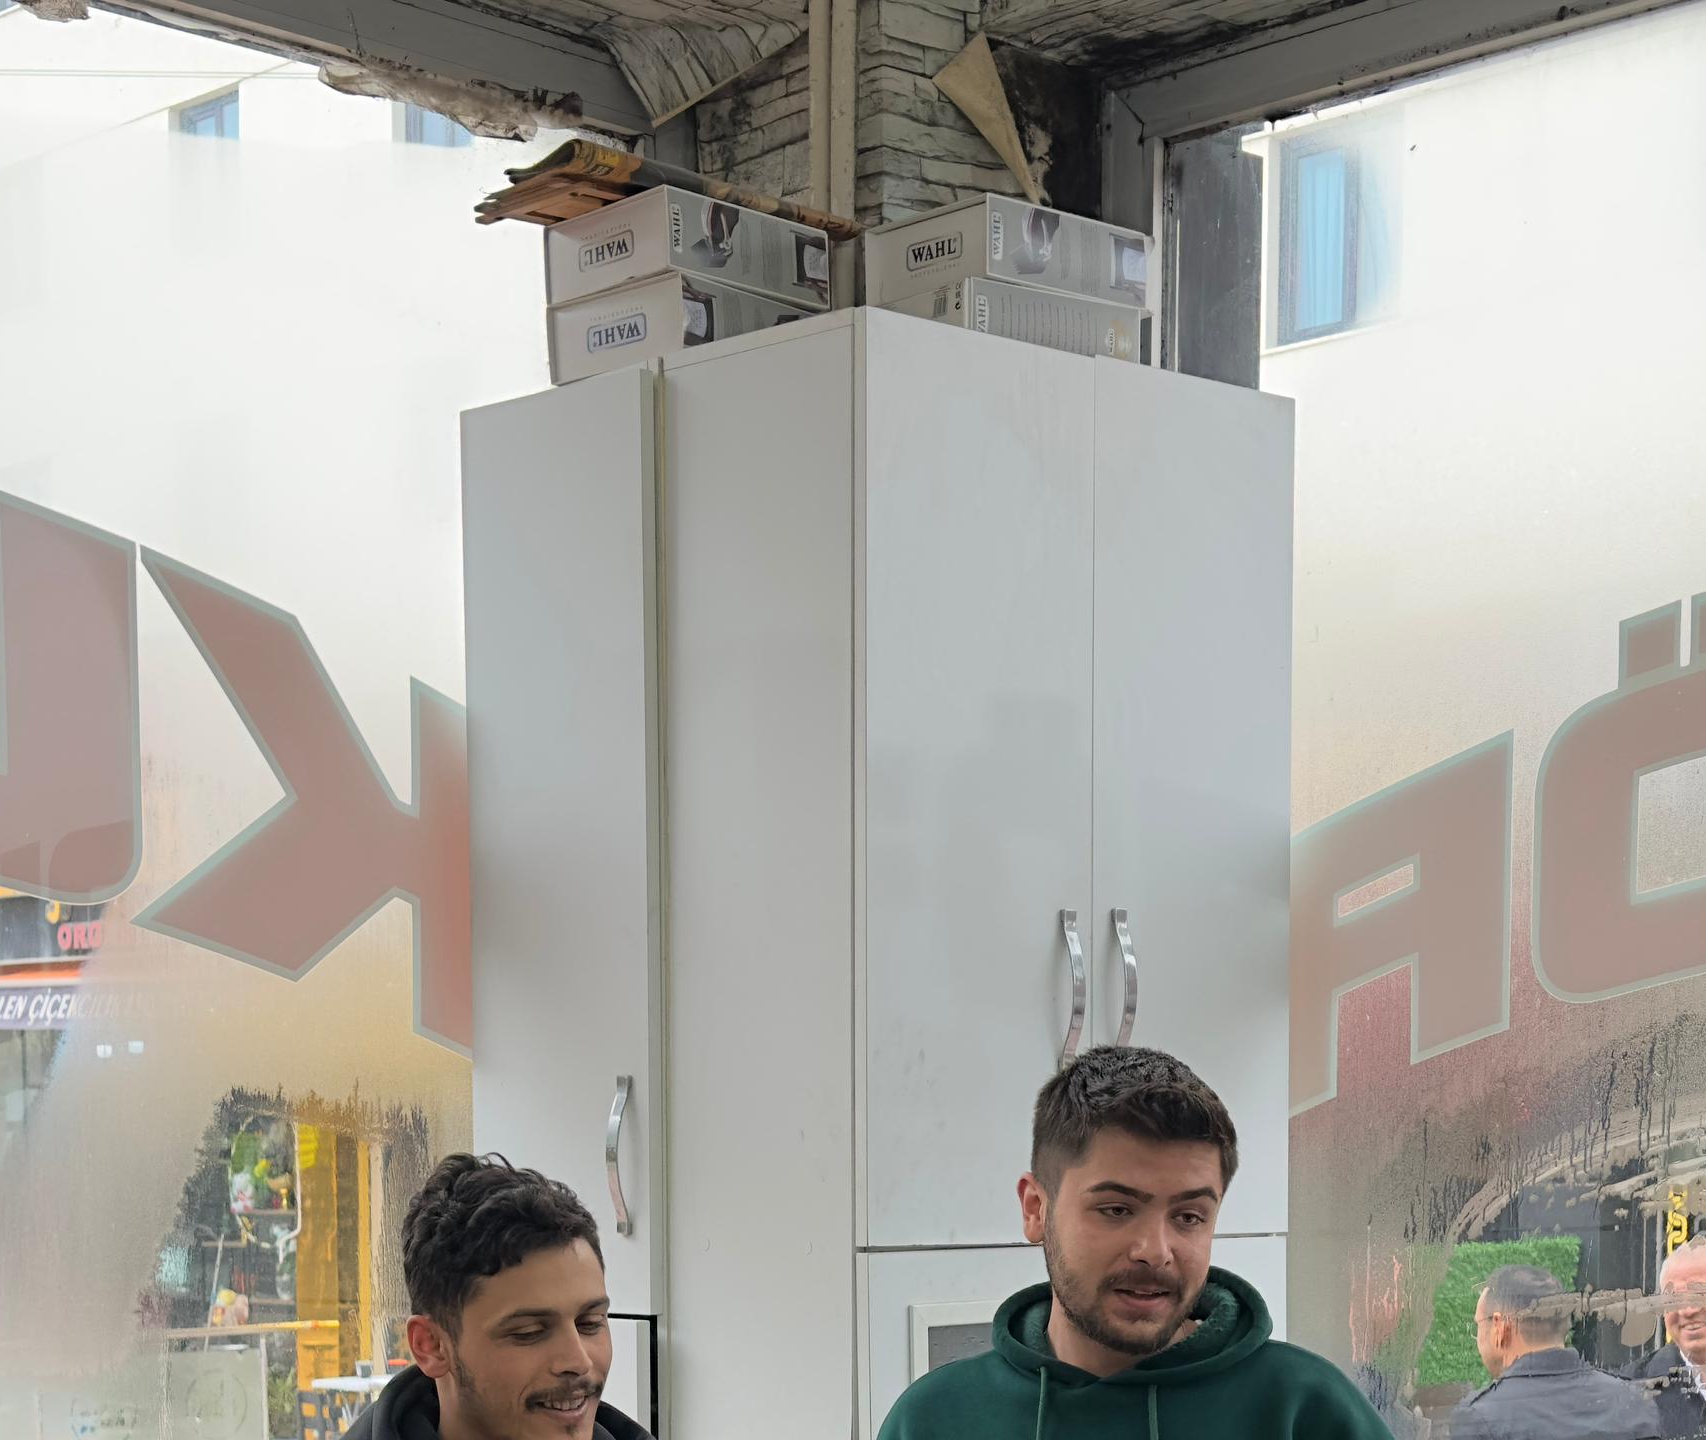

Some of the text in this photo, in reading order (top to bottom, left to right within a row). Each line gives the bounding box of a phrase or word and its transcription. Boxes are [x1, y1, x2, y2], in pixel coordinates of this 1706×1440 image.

[672, 207, 682, 248] WAHL
[993, 213, 1002, 256] WAHL
[585, 238, 630, 266] WAHL
[911, 238, 957, 264] WAHL
[594, 320, 641, 347] WAHL
